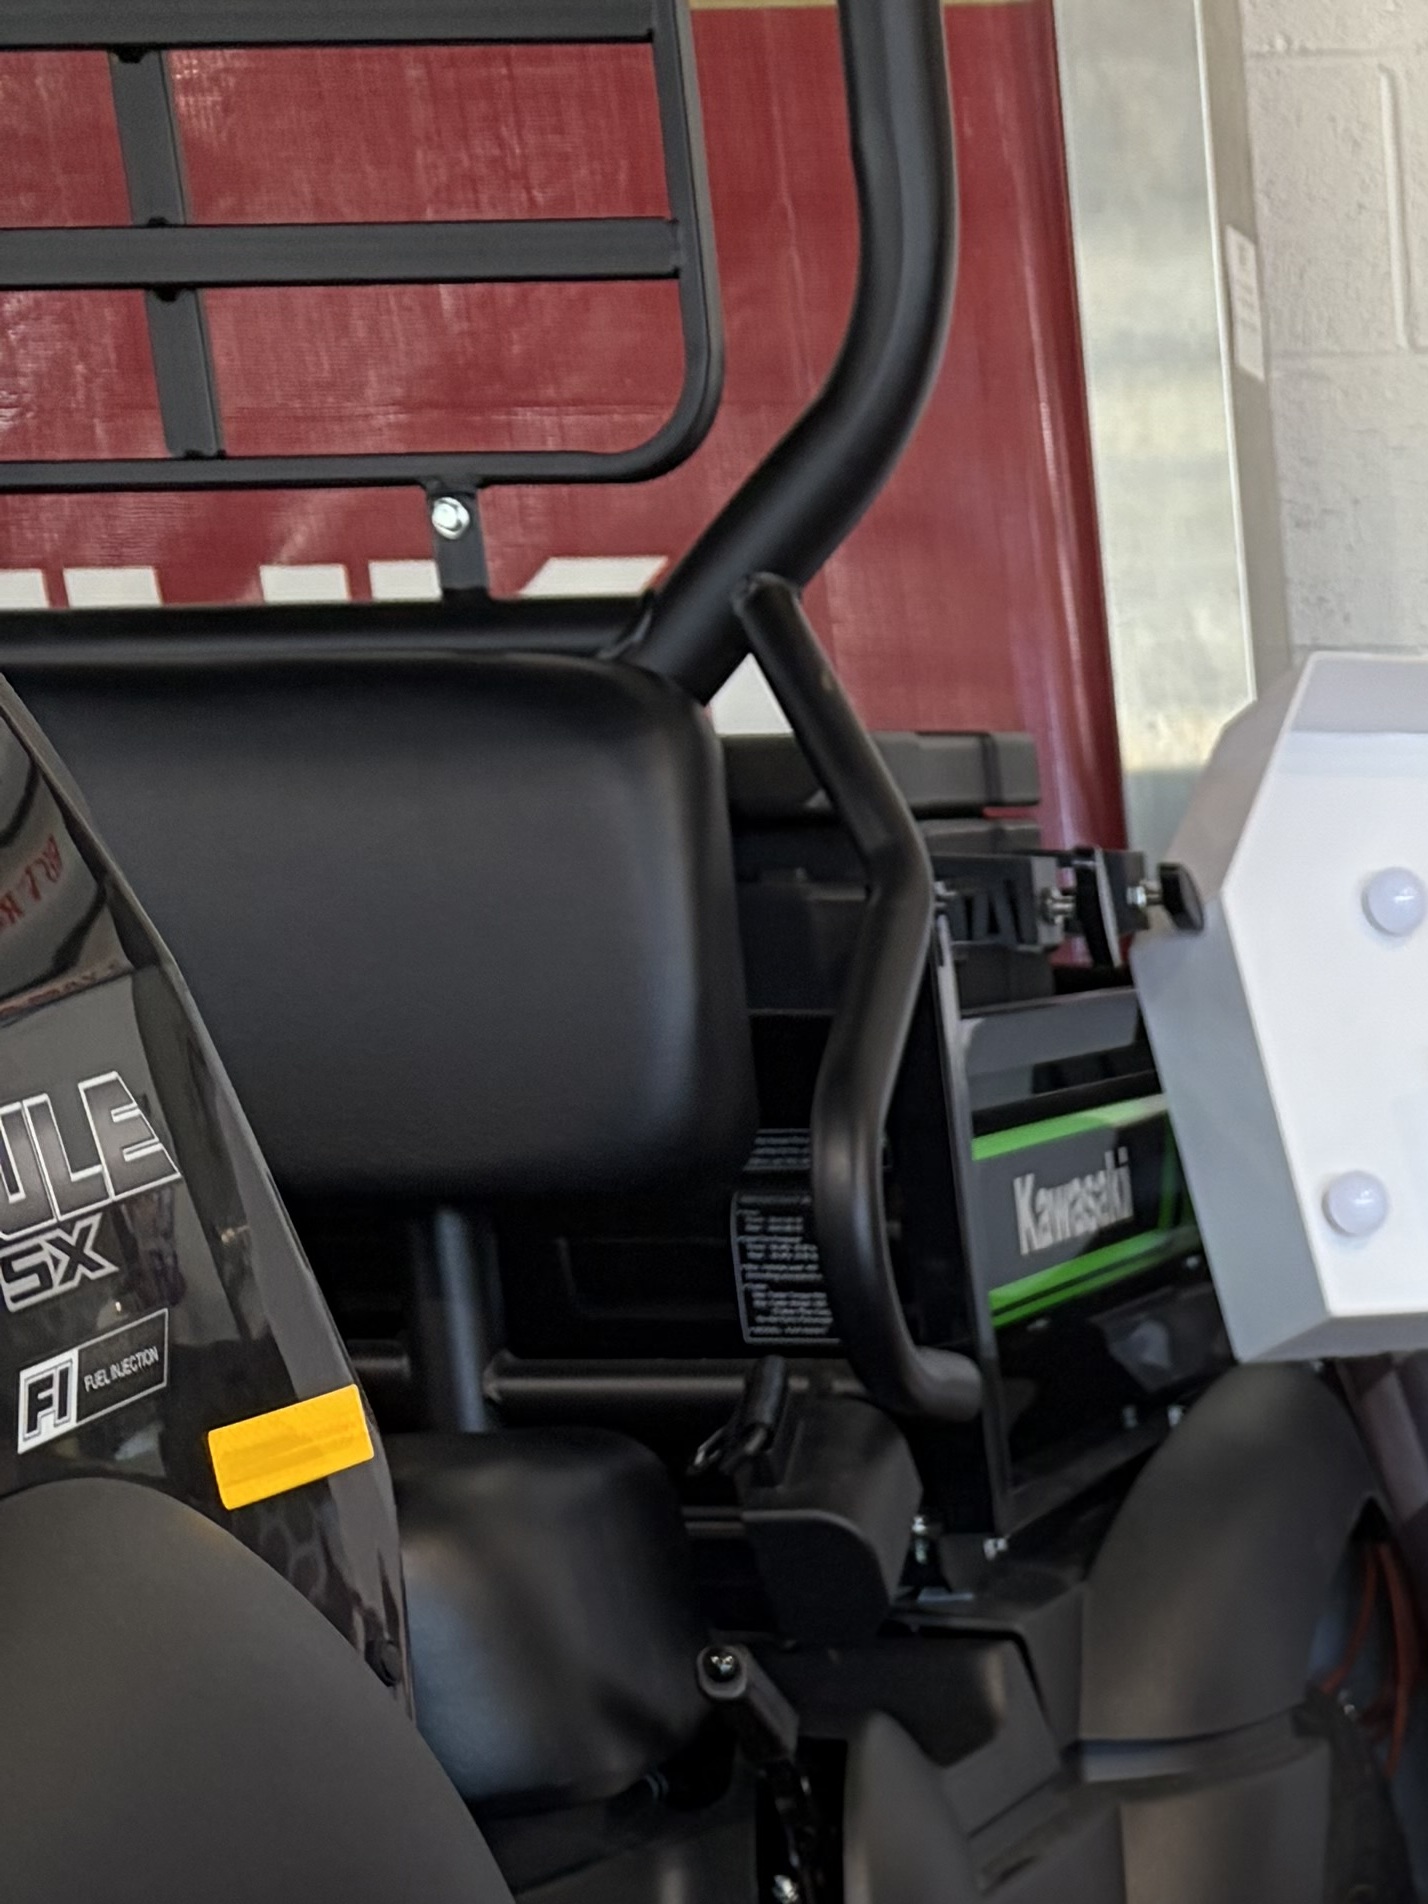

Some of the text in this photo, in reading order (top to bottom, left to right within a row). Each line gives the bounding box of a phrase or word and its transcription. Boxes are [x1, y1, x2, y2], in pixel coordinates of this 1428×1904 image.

[1014, 1146, 1134, 1256] Kawasaki
[21, 1360, 75, 1444] FI
[84, 1346, 159, 1392] FUEL INJECTION
